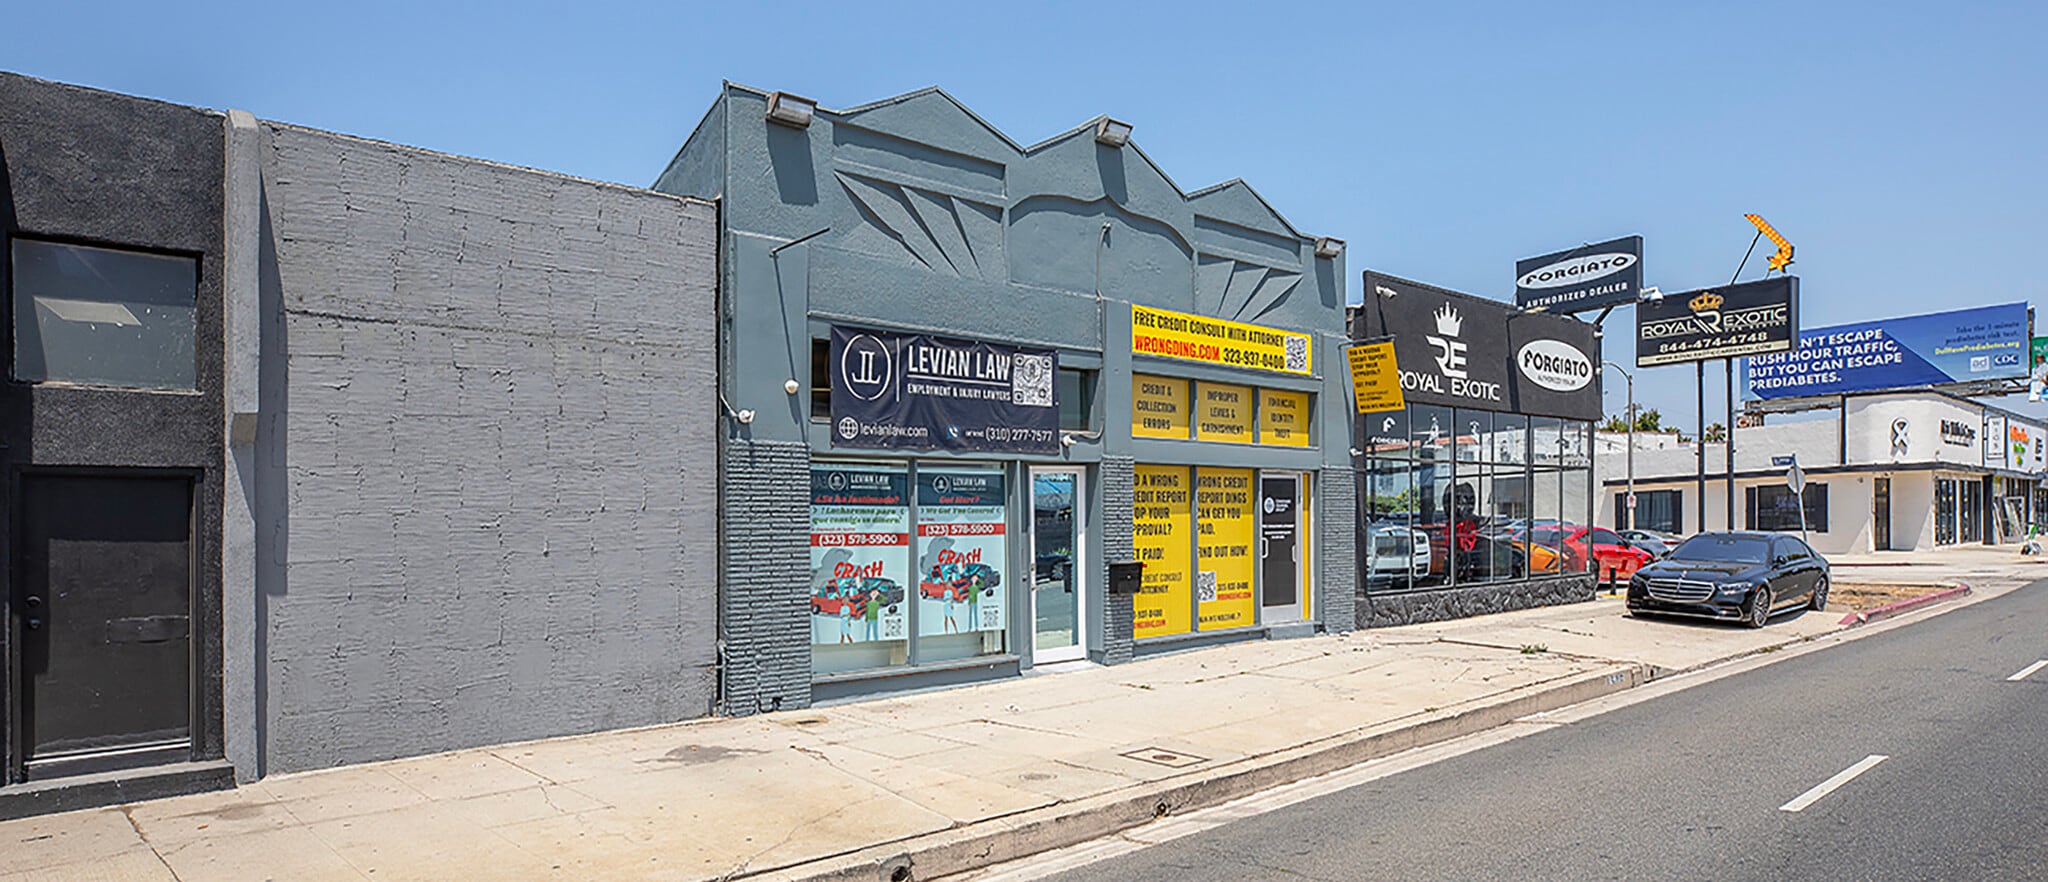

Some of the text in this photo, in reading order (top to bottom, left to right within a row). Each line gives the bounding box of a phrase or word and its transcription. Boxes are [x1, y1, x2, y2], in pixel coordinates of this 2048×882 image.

[1525, 256, 1628, 285] FORGIATO
[1526, 282, 1628, 309] AUTHORIZED DEALER
[1134, 311, 1285, 347] FREE CREDIT CONSULT WITH ATTORNEY
[1641, 319, 1699, 339] ROYAL
[1723, 307, 1787, 326] EXOTIC
[1659, 332, 1768, 353] 844-474-4748
[1801, 329, 1883, 349] N'T ESCAPE
[1134, 335, 1286, 369] WRONGDING.COM 323-937-0400
[1748, 340, 1898, 367] RUSH HOUR TRAFFIC,
[1994, 354, 2018, 364] CDC
[908, 345, 1011, 381] LEVIAN LAW
[1524, 350, 1589, 378] FORGIATO
[1748, 352, 1902, 379] BUT YOU CAN ESCAPE
[1141, 383, 1172, 396] CREDIT &
[1398, 370, 1500, 401] ROYAL EXOTIC
[1749, 372, 1842, 391] PREDIABETES.
[907, 383, 951, 396] EMPLOYMENT
[960, 387, 981, 399] INJURY
[983, 389, 1011, 401] LAWYERS
[1136, 400, 1177, 413] COLLECTION
[860, 423, 929, 438] levianlaw.com
[1143, 417, 1171, 430] ERRORS
[985, 426, 1011, 442] (310)
[1142, 474, 1148, 486] A
[1150, 474, 1179, 487] WRONG
[1223, 476, 1248, 489] CREDIT
[1134, 490, 1187, 503] EDIT REPORT
[1225, 491, 1247, 504] DINGS
[1134, 506, 1170, 520] OP YOUR
[1212, 507, 1225, 519] GET
[1227, 507, 1241, 519] YOU
[926, 523, 995, 536] (323) 578-5900
[1133, 523, 1173, 536] PPROVAL?
[819, 533, 898, 546] (323) 578-5900
[938, 547, 982, 566] CRASH
[1214, 546, 1228, 558] OUT
[834, 560, 884, 579] CRASH
